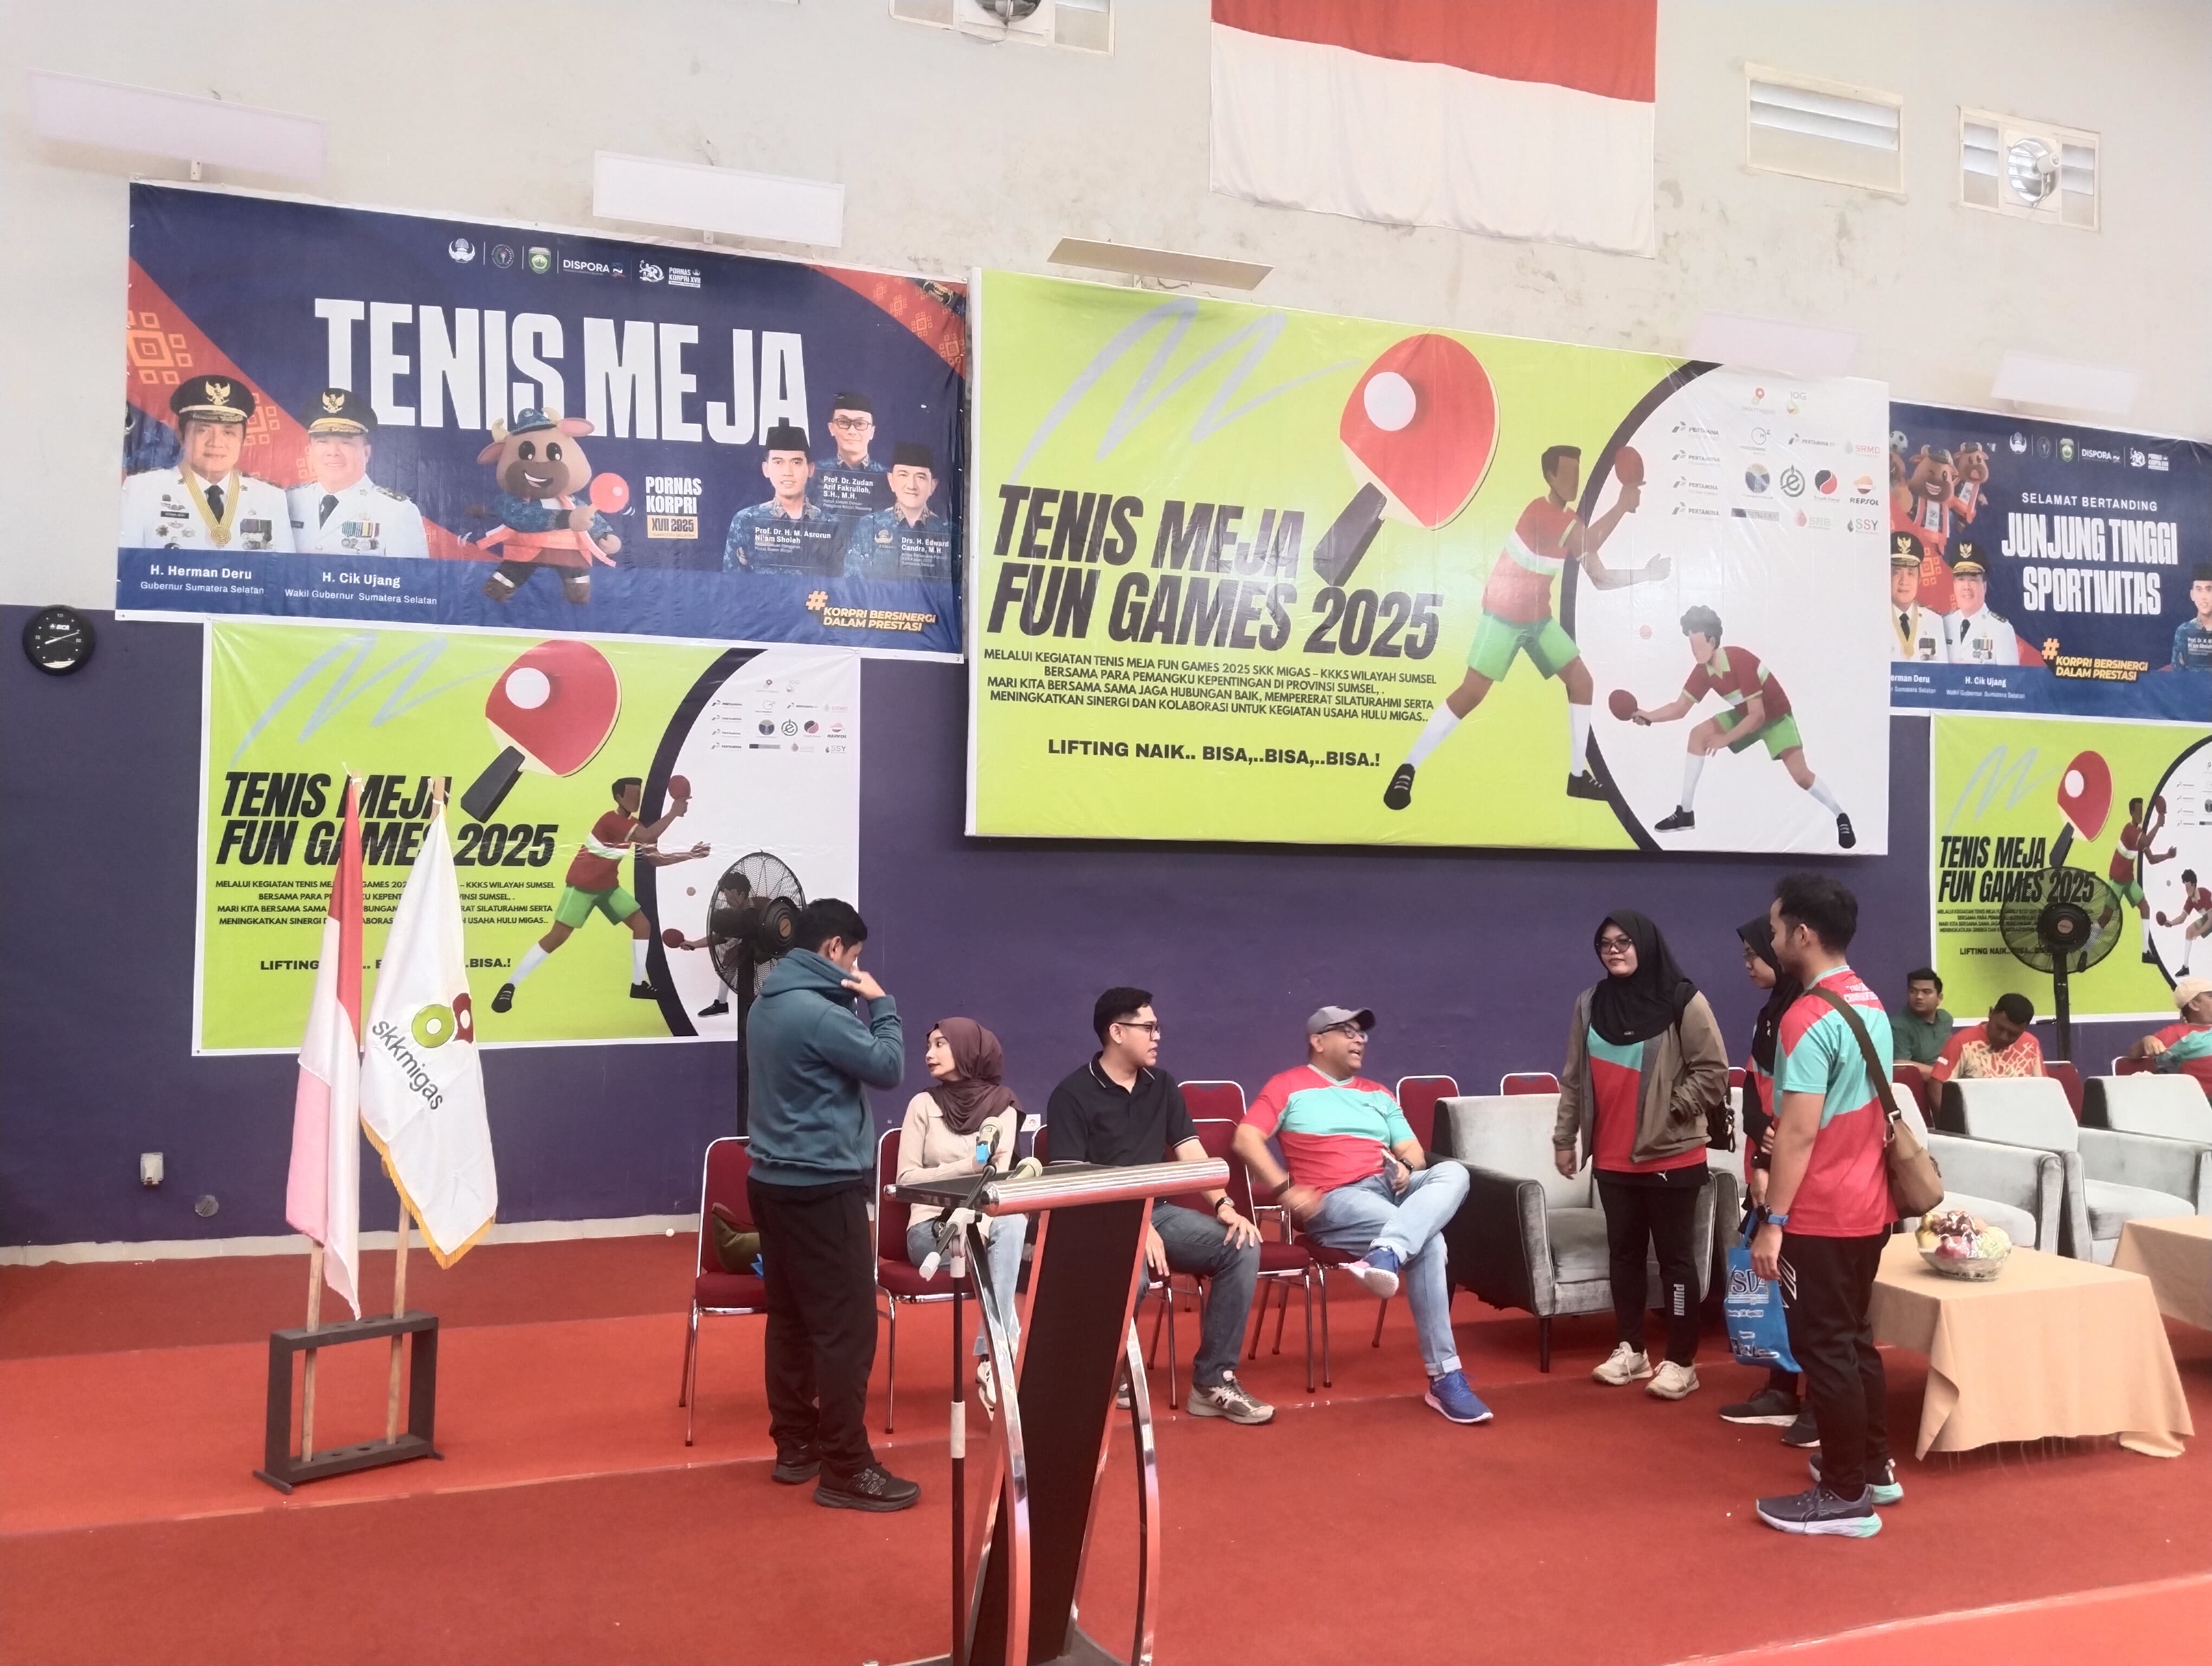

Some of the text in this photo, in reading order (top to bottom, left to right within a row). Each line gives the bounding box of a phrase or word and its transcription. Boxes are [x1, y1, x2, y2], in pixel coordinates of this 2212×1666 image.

[563, 259, 610, 273] DISPORA
[315, 298, 810, 447] TENIS MEJA
[2081, 448, 2112, 460] DISPORA
[645, 476, 702, 495] PORNAS
[837, 484, 871, 495] Fakrulloh,
[646, 496, 697, 514] KORPRI
[1850, 497, 1879, 506] REPSOL
[2022, 492, 2158, 511] SELAMAT BERTANDING
[652, 518, 694, 532] XVII 2025
[993, 484, 1305, 578] TENIS MEJA
[1856, 518, 1878, 530] SSY
[2001, 512, 2178, 565] JUNJUNG TINGGI
[902, 544, 927, 553] Candra,
[151, 565, 252, 579] H. Herman Deru
[322, 572, 401, 588] H. Cik Ujang
[140, 581, 264, 594] Gubernur Sumatera Selatan
[2023, 566, 2161, 615] SPORTIVITAS
[285, 588, 437, 605] Wakil Gubernur Sumatera Selatan
[824, 607, 937, 623] KORPRI BERSINERGI
[987, 562, 1444, 660] FUN GAMES 2025
[823, 617, 922, 631] DALAM PRESTASI
[984, 649, 1032, 662] MELALUI
[1036, 652, 1091, 665] KEGIATAN
[1094, 655, 1124, 667] TENIS
[1127, 657, 1155, 669] MEJA
[1158, 659, 1179, 670] FUN
[1181, 661, 1219, 672] GAMES
[1222, 663, 1250, 674] 2025
[1252, 665, 1274, 676] SKK
[1277, 667, 1310, 677] MIGAS
[1321, 669, 1349, 680] KKKS
[1351, 670, 1396, 682] WILAYAH
[1399, 673, 1437, 684] SUMSEL
[2056, 656, 2148, 671] KORPRI BERSINERGI
[1044, 666, 1097, 679] BERSAMA
[1101, 669, 1130, 681] PARA
[1133, 671, 1195, 684] PEMANGKU
[1198, 675, 1271, 688] KEPENTINGAN
[1274, 680, 1284, 689] DI
[1287, 680, 1335, 692] PROVINSI
[1891, 675, 1930, 683] erman Deru
[1965, 676, 2007, 688] H. Cik Ujang
[2056, 667, 2137, 681] DALAM PRESTASI
[987, 676, 1434, 709] MARI KITA BERSAMA SAMA JAGA HUBUNGAN BAIK, MEMPERERAT SILATURAHMI SERTA
[990, 690, 1084, 705] MENINGKATKAN
[1086, 695, 1129, 707] SINERGI
[1132, 698, 1156, 709] DAN
[1159, 700, 1228, 712] KOLABORASI
[1231, 703, 1267, 714] UNTUK
[1269, 706, 1321, 717] KEGIATAN
[1323, 708, 1358, 719] USAHA
[1361, 709, 1387, 720] HULU
[1049, 739, 1128, 757] LIFTING
[1136, 743, 1195, 759] NAIK..
[221, 772, 331, 817] TENIS
[216, 820, 559, 867] FUN 2025
[1940, 836, 2046, 868] TENIS MEJA
[1938, 870, 2095, 902] FUN GAMES 2025
[261, 960, 320, 970] LIFTING
[372, 1020, 443, 1110] skkmigas
